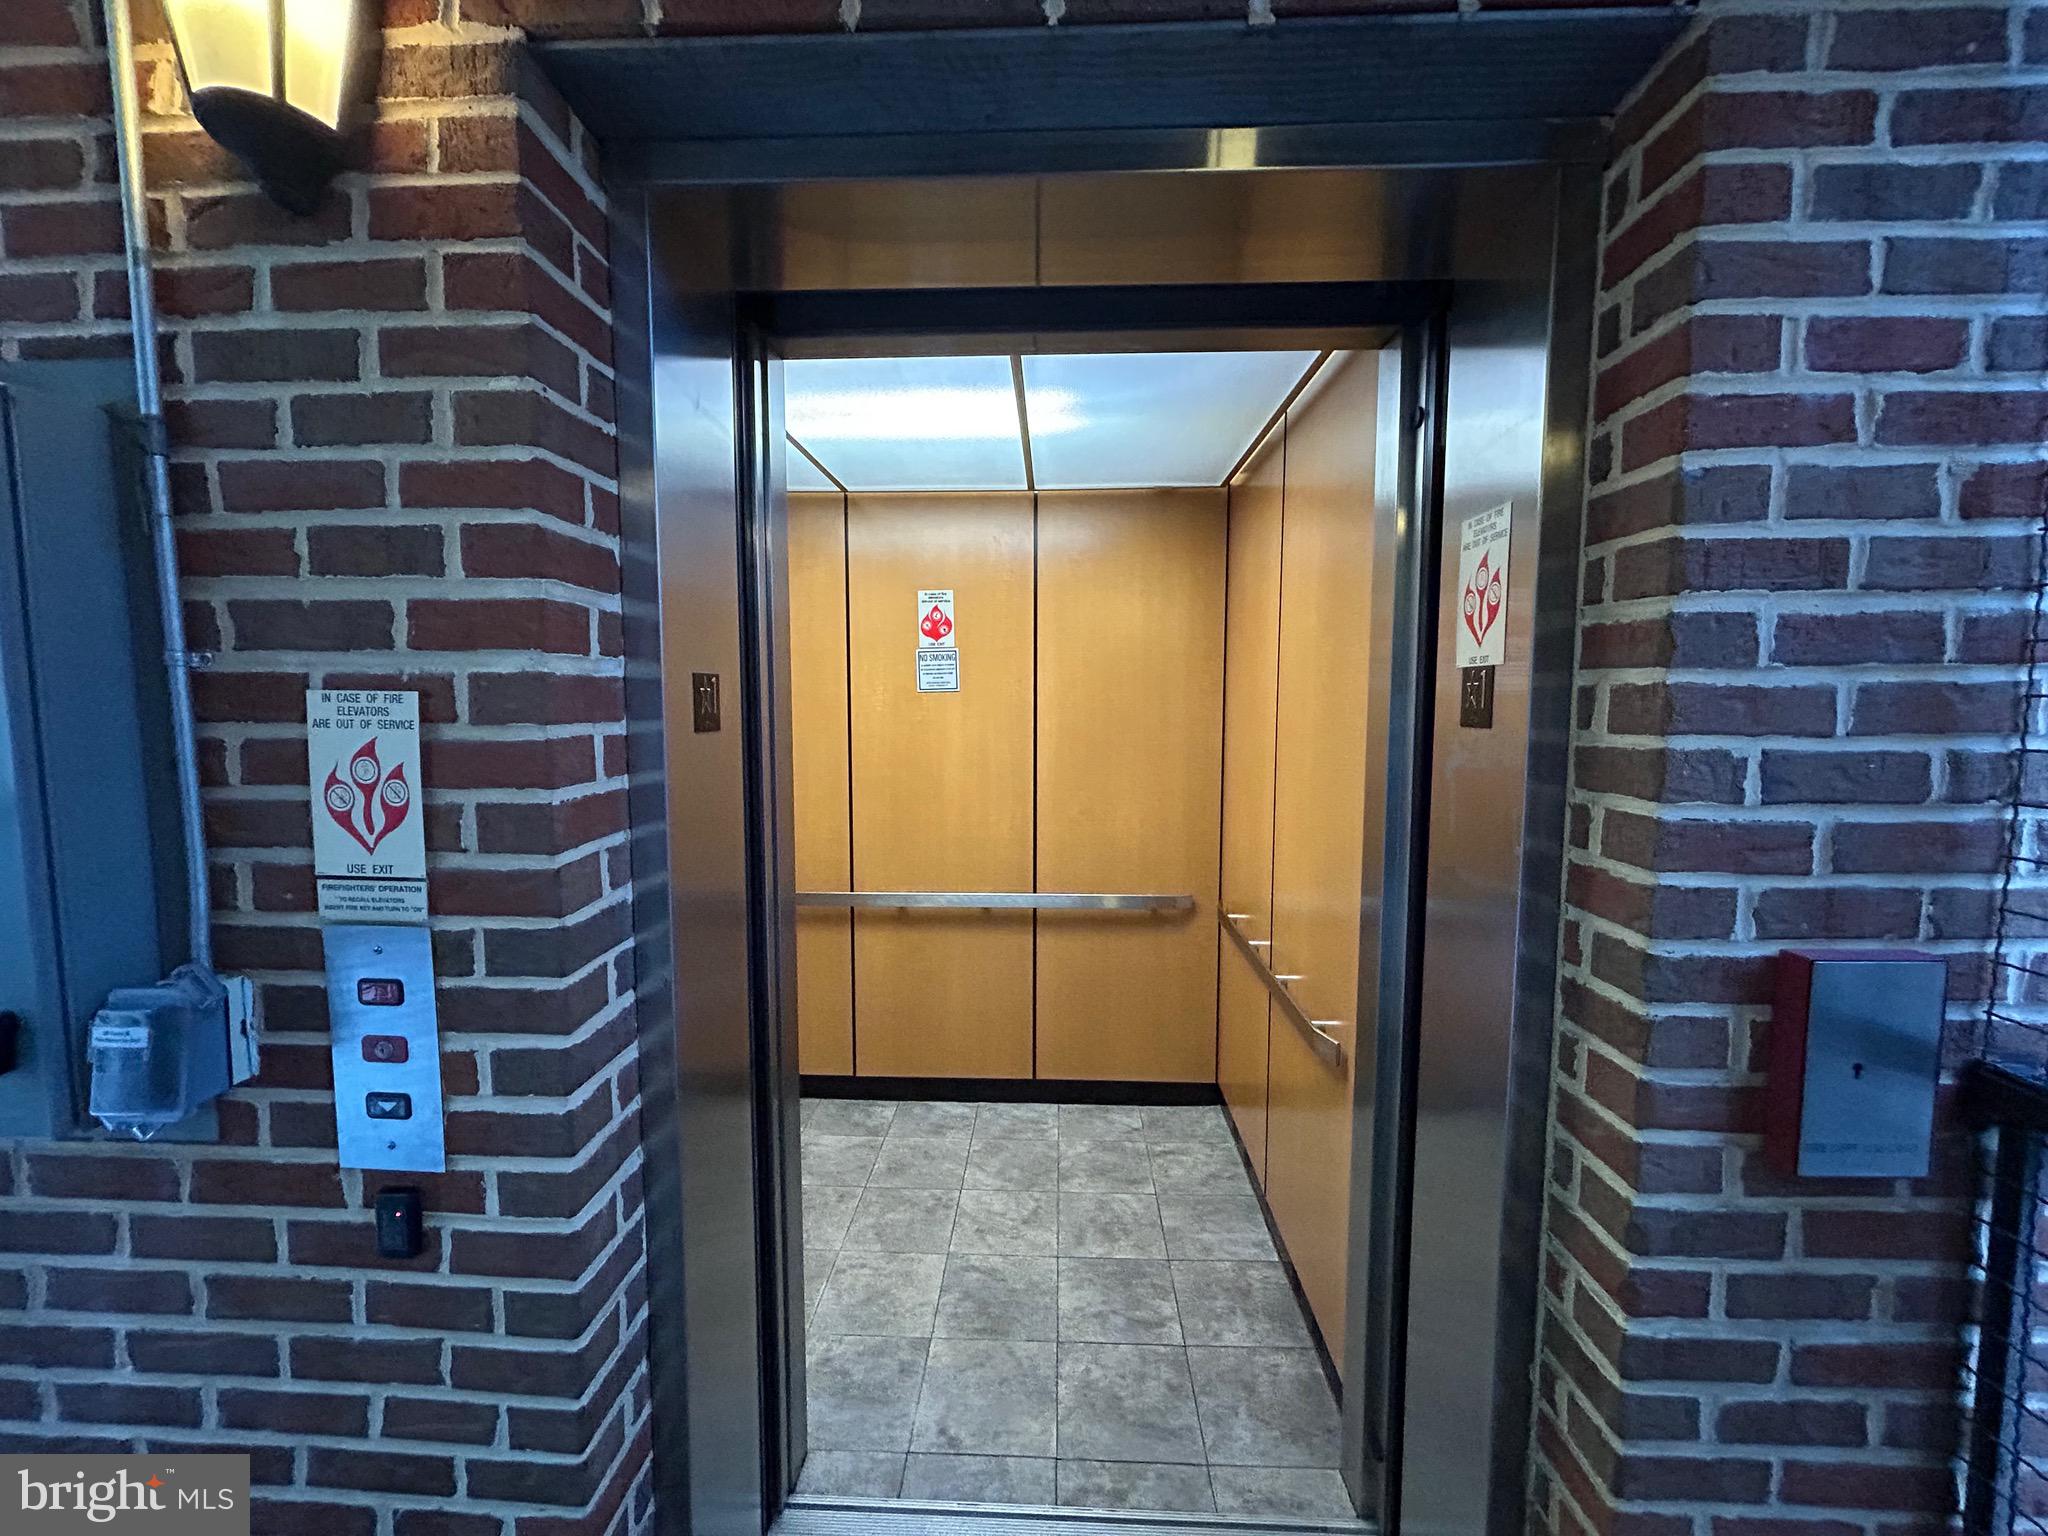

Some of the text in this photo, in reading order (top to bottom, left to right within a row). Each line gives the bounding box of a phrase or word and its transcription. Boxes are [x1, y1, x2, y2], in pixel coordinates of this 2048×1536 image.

[919, 653, 956, 662] NO SMOKING
[1469, 654, 1490, 665] USE EXIT
[321, 693, 404, 704] IN CASE OF FIRE
[337, 706, 390, 717] ELEVATORS
[312, 718, 415, 730] ARE OUT OF SERVICE
[346, 864, 394, 875] USE EXIT
[378, 885, 422, 893] OPERATION
